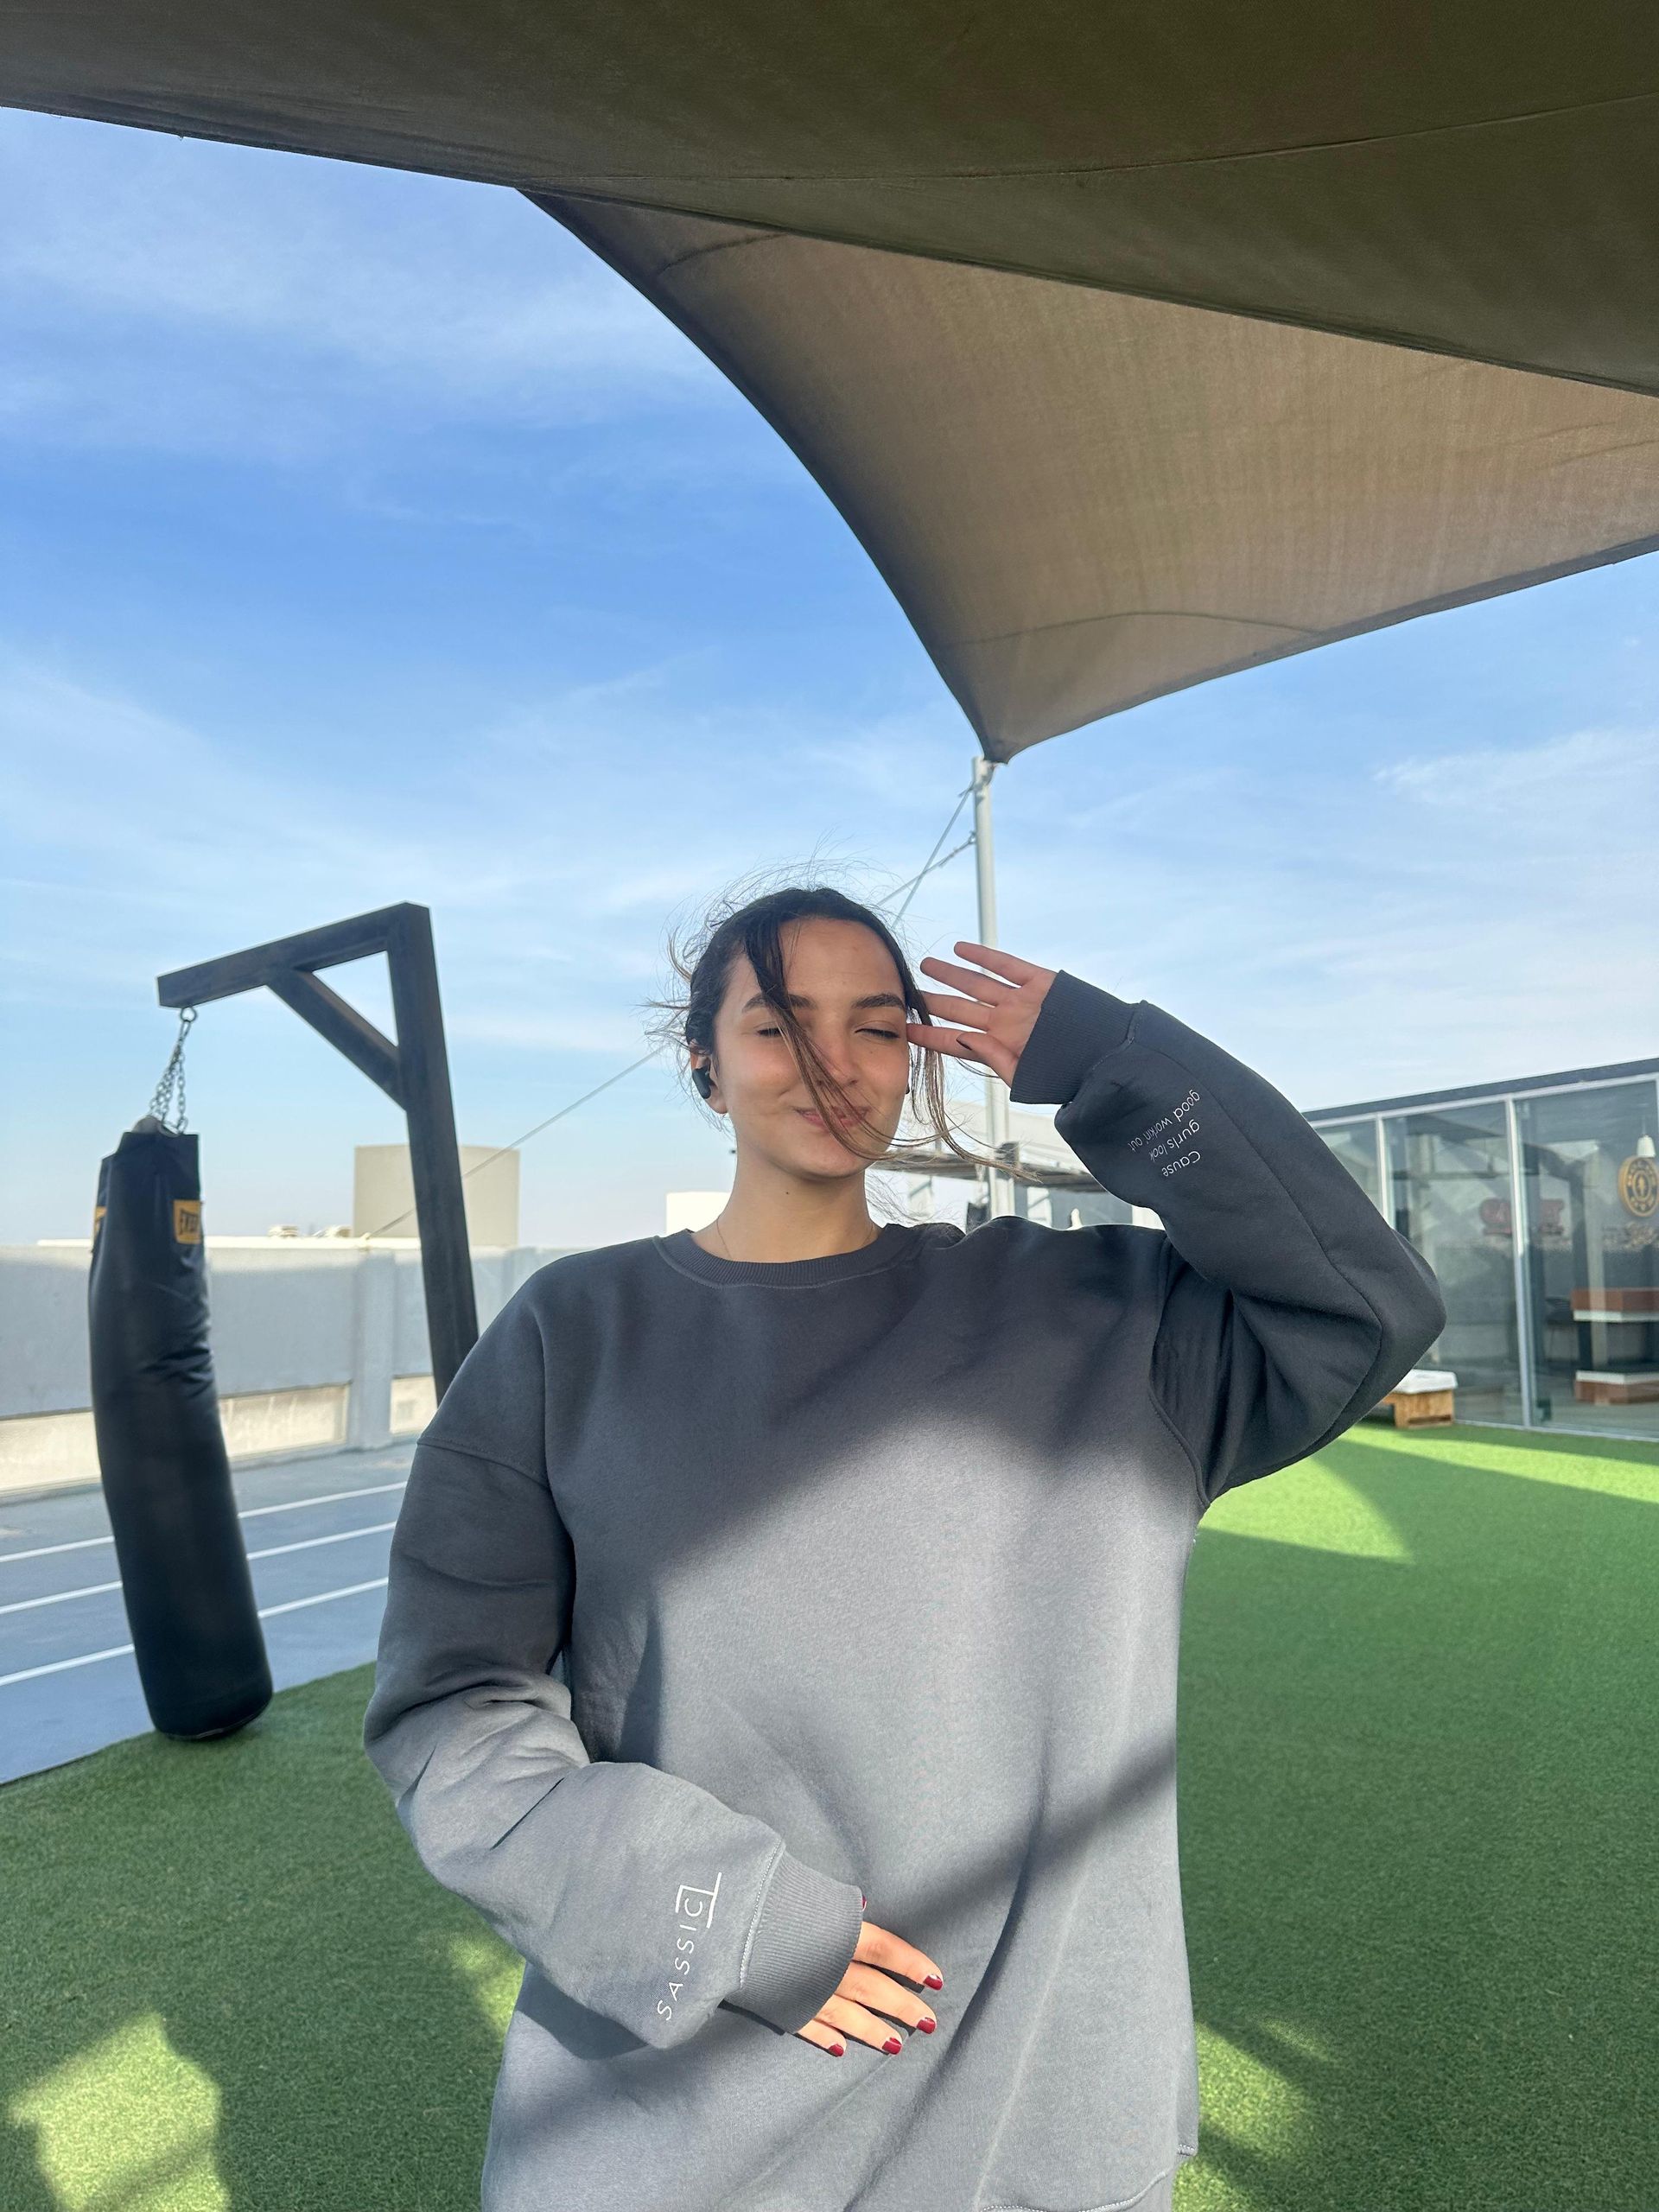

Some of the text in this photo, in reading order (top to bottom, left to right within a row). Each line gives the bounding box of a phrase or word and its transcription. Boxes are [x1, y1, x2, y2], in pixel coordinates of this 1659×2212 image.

[1173, 1089, 1200, 1122] good
[1128, 1136, 1143, 1153] out
[1149, 1119, 1200, 1163] gurls look
[1161, 1150, 1201, 1177] Cause
